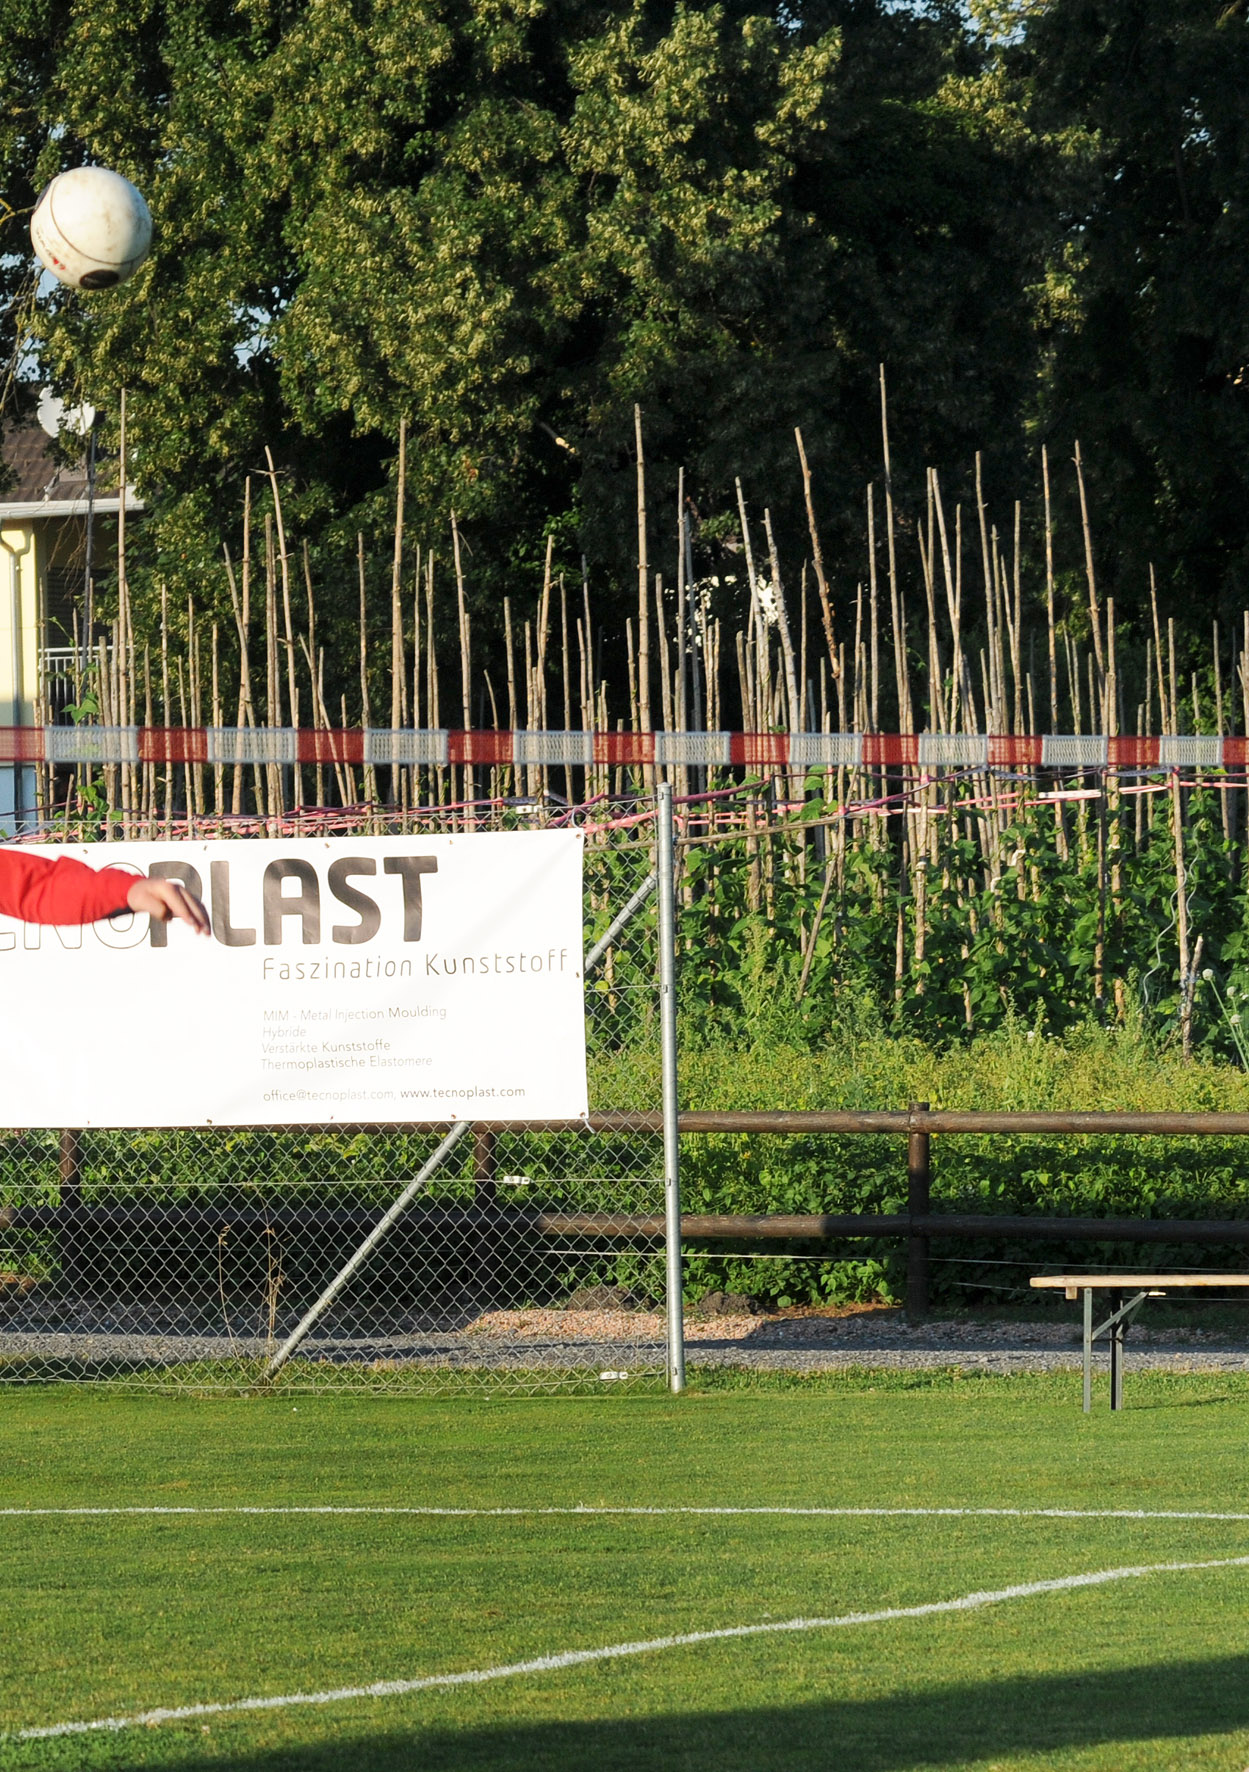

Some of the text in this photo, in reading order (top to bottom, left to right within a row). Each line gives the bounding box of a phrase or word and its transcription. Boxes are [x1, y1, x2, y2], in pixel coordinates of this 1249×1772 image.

[263, 949, 567, 980] Faszination Kunststoff
[263, 1009, 289, 1022] MIM
[300, 1008, 332, 1021] Metal
[335, 1008, 384, 1023] Injection
[388, 1005, 447, 1020] Moulding
[263, 1025, 307, 1040] Hybride
[261, 1038, 391, 1055] Verstärkte Kunststoffe
[261, 1055, 433, 1072] Thermoplastische Elastomere
[400, 1085, 526, 1100] www.tecnoplast.com
